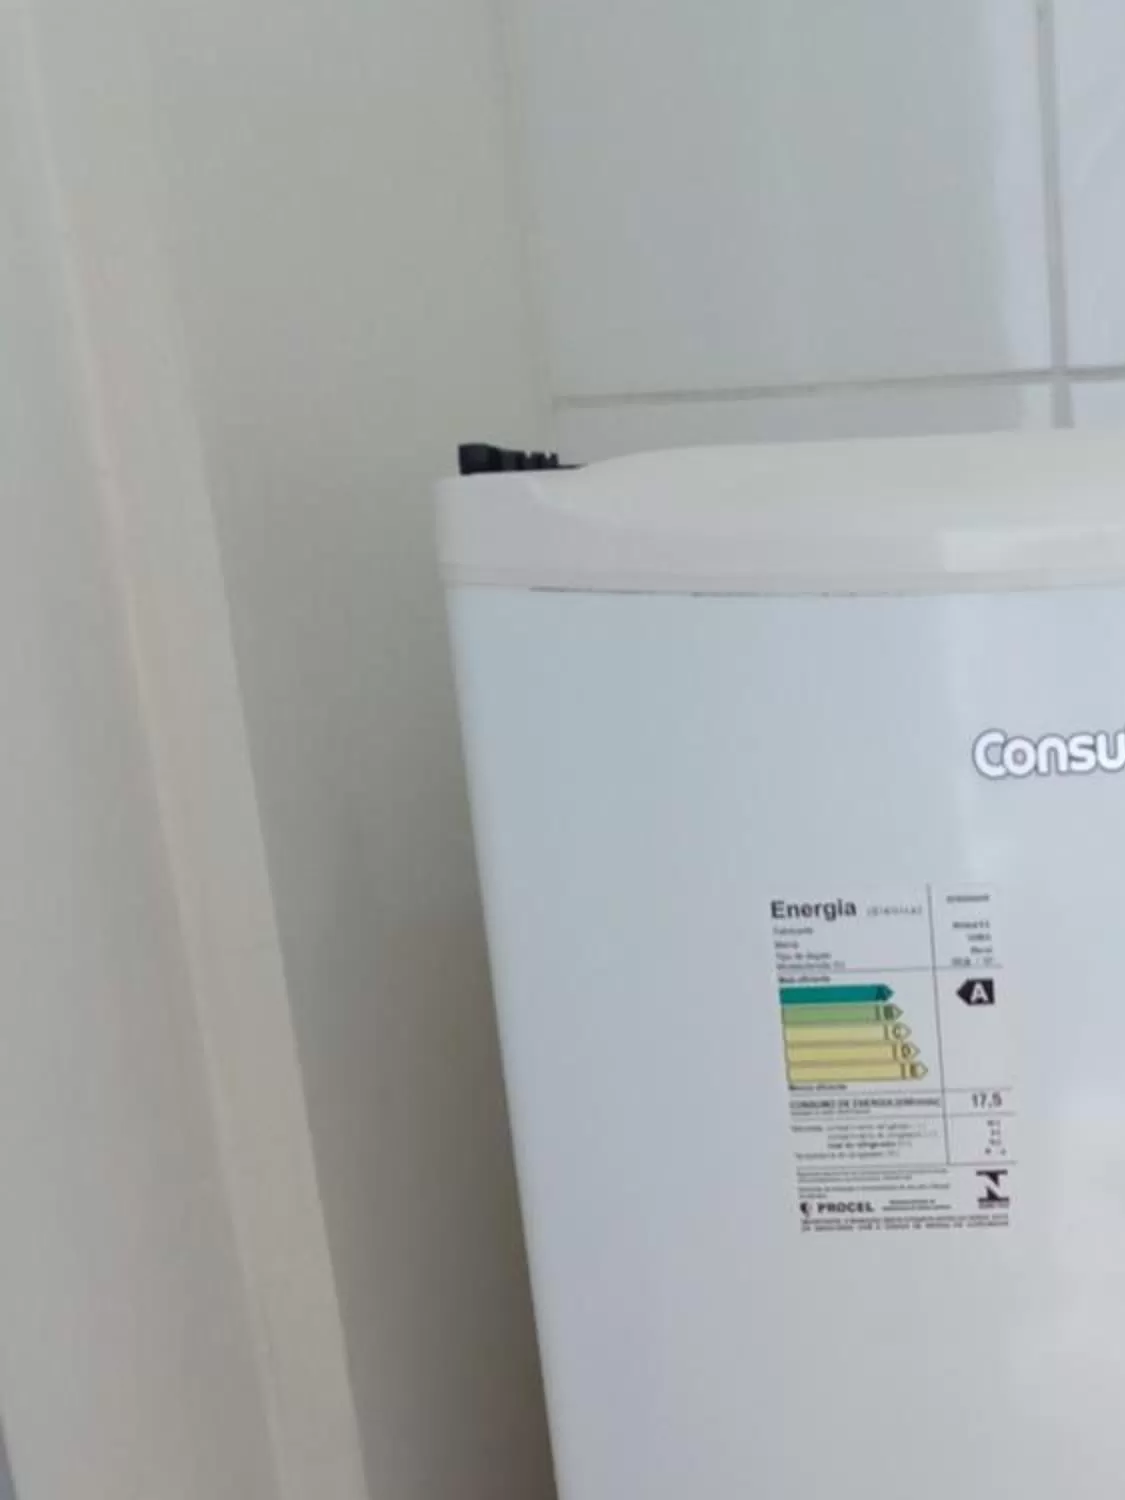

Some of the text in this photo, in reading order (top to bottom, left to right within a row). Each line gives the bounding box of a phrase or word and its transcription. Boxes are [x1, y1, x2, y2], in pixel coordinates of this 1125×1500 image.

[770, 898, 857, 921] Energia
[970, 981, 989, 1003] A
[817, 1202, 875, 1214] PROCEL
